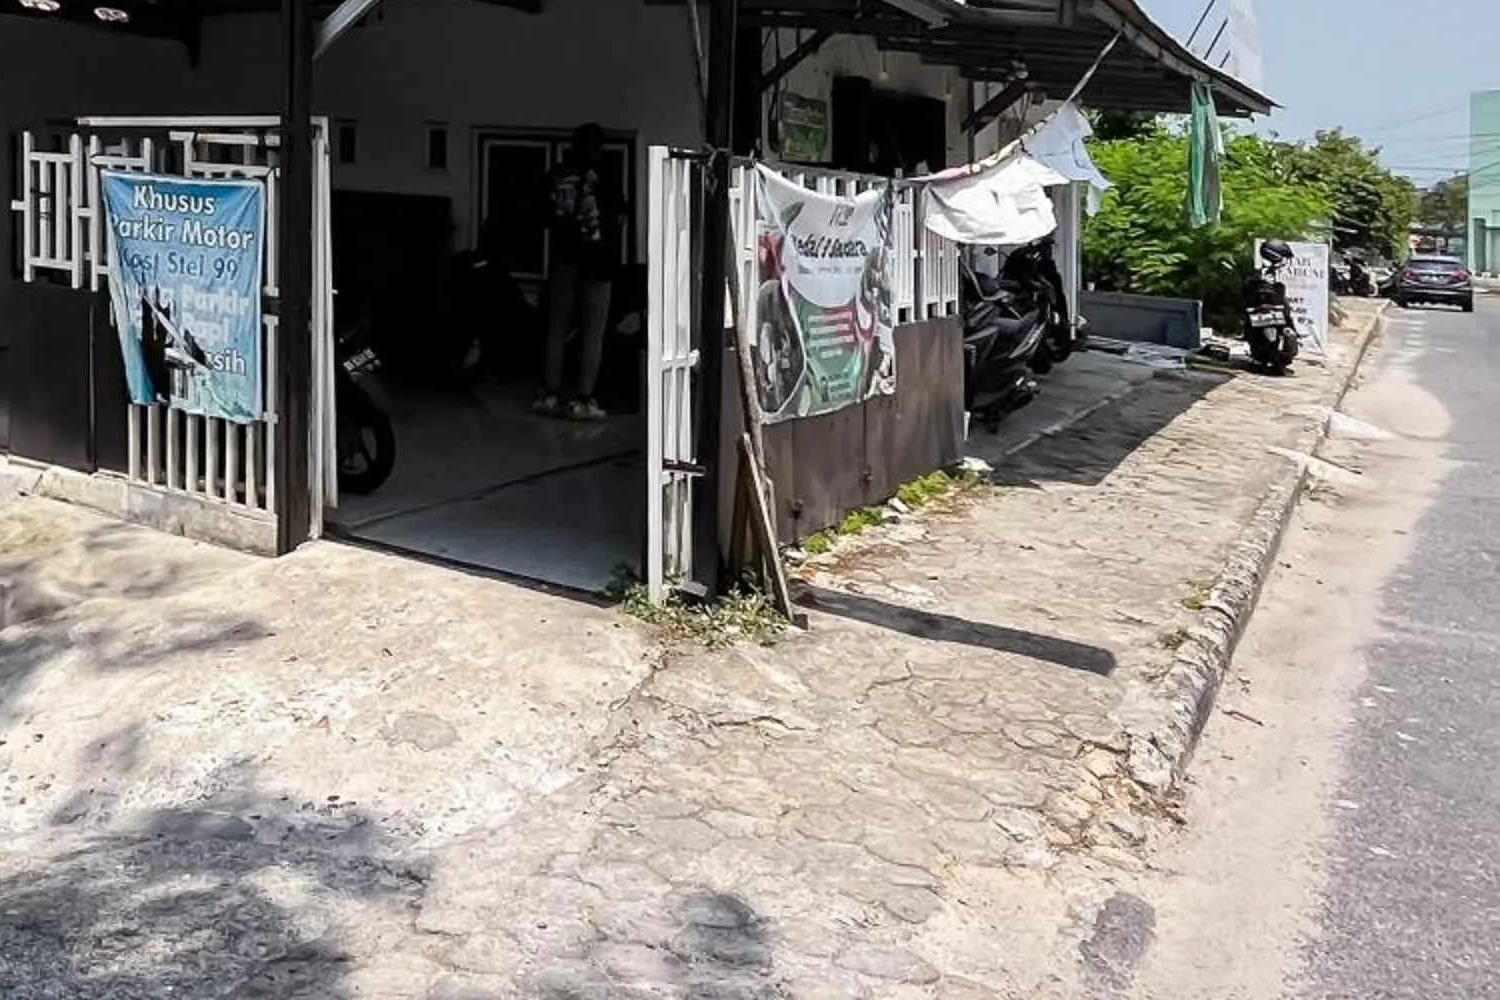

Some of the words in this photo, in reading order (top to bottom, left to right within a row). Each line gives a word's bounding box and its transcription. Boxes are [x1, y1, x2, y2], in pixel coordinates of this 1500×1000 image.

[133, 185, 216, 215] Khusus
[113, 213, 175, 242] arkir
[181, 218, 253, 249] Motor
[213, 257, 239, 280] 99
